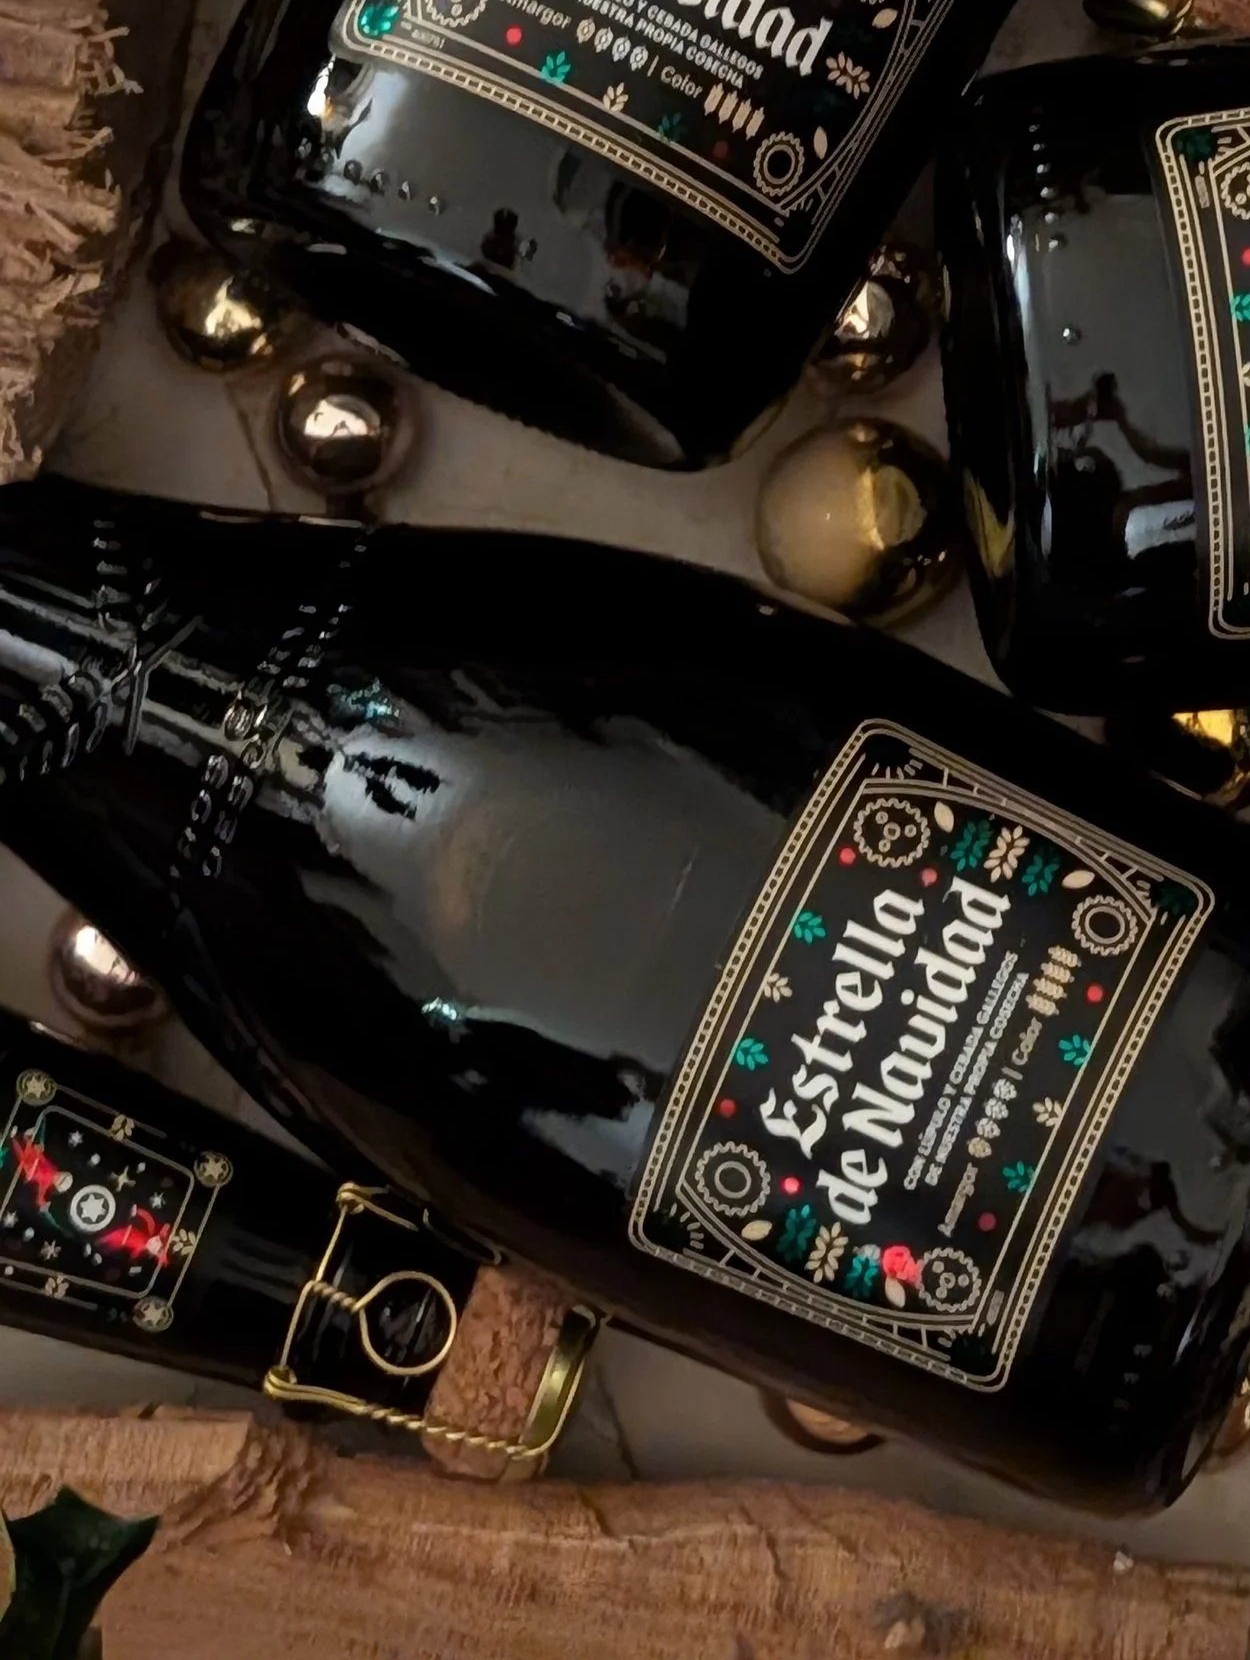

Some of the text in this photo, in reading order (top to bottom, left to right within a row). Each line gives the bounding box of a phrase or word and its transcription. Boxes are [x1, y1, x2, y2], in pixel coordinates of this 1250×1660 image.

[635, 18, 683, 54] PROPIA
[686, 46, 743, 88] COSECHA
[648, 5, 698, 43] CEBADA
[700, 34, 763, 79] GALLEGOS
[661, 66, 702, 98] Color
[760, 890, 924, 1158] Estrella
[816, 876, 1011, 1224] de Navidad
